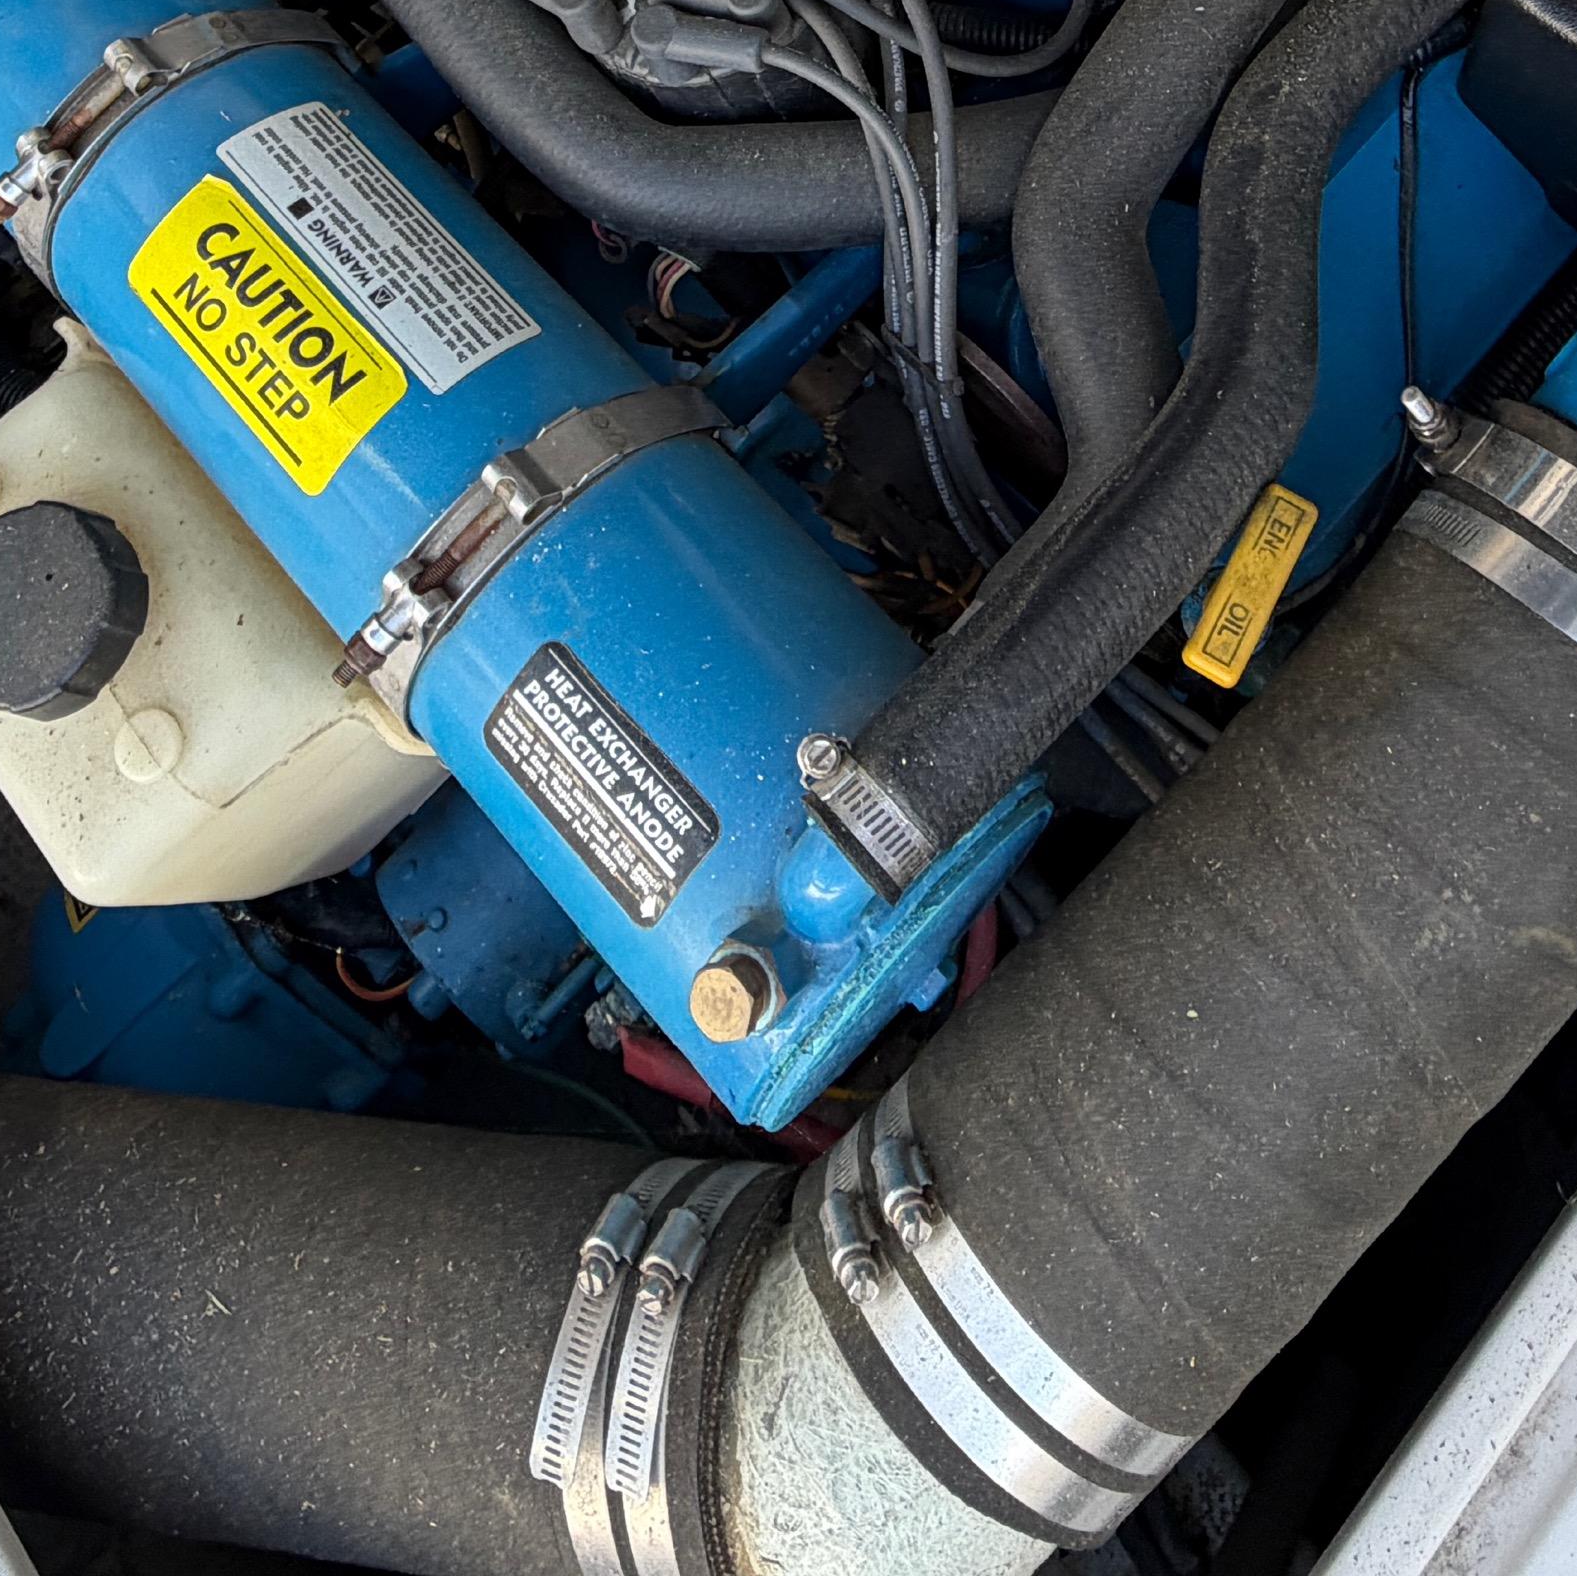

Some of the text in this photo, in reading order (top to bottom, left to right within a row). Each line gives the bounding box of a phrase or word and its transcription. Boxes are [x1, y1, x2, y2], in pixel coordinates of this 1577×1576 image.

[196, 222, 368, 407] CAUTION
[307, 218, 375, 289] WARNING
[173, 272, 311, 421] NO STEP
[1259, 518, 1293, 560] EN
[1217, 601, 1252, 638] OIL
[523, 679, 684, 863] PROTECTIVE ANODE
[544, 667, 693, 836] HEAT EXCHANGER
